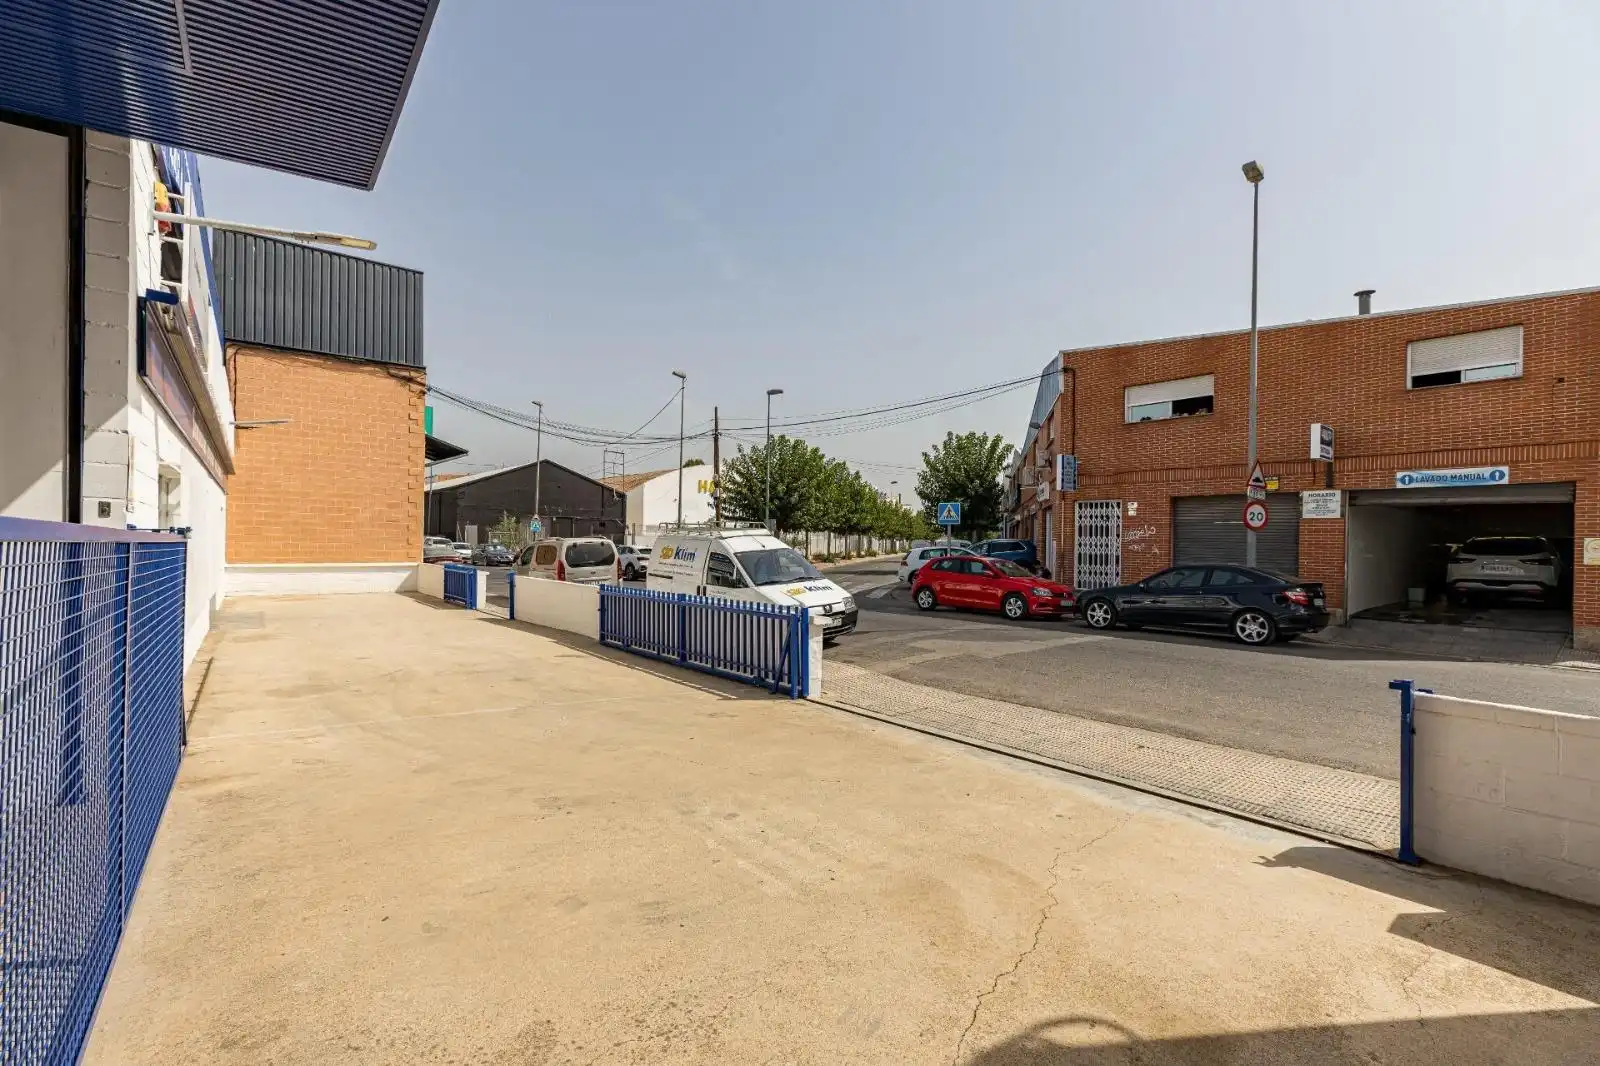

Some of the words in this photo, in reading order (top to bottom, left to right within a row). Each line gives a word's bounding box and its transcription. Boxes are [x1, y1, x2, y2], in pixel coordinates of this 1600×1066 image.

[1415, 475, 1448, 483] LAVADO
[1450, 473, 1487, 481] MANUAL
[1249, 511, 1264, 522] 20
